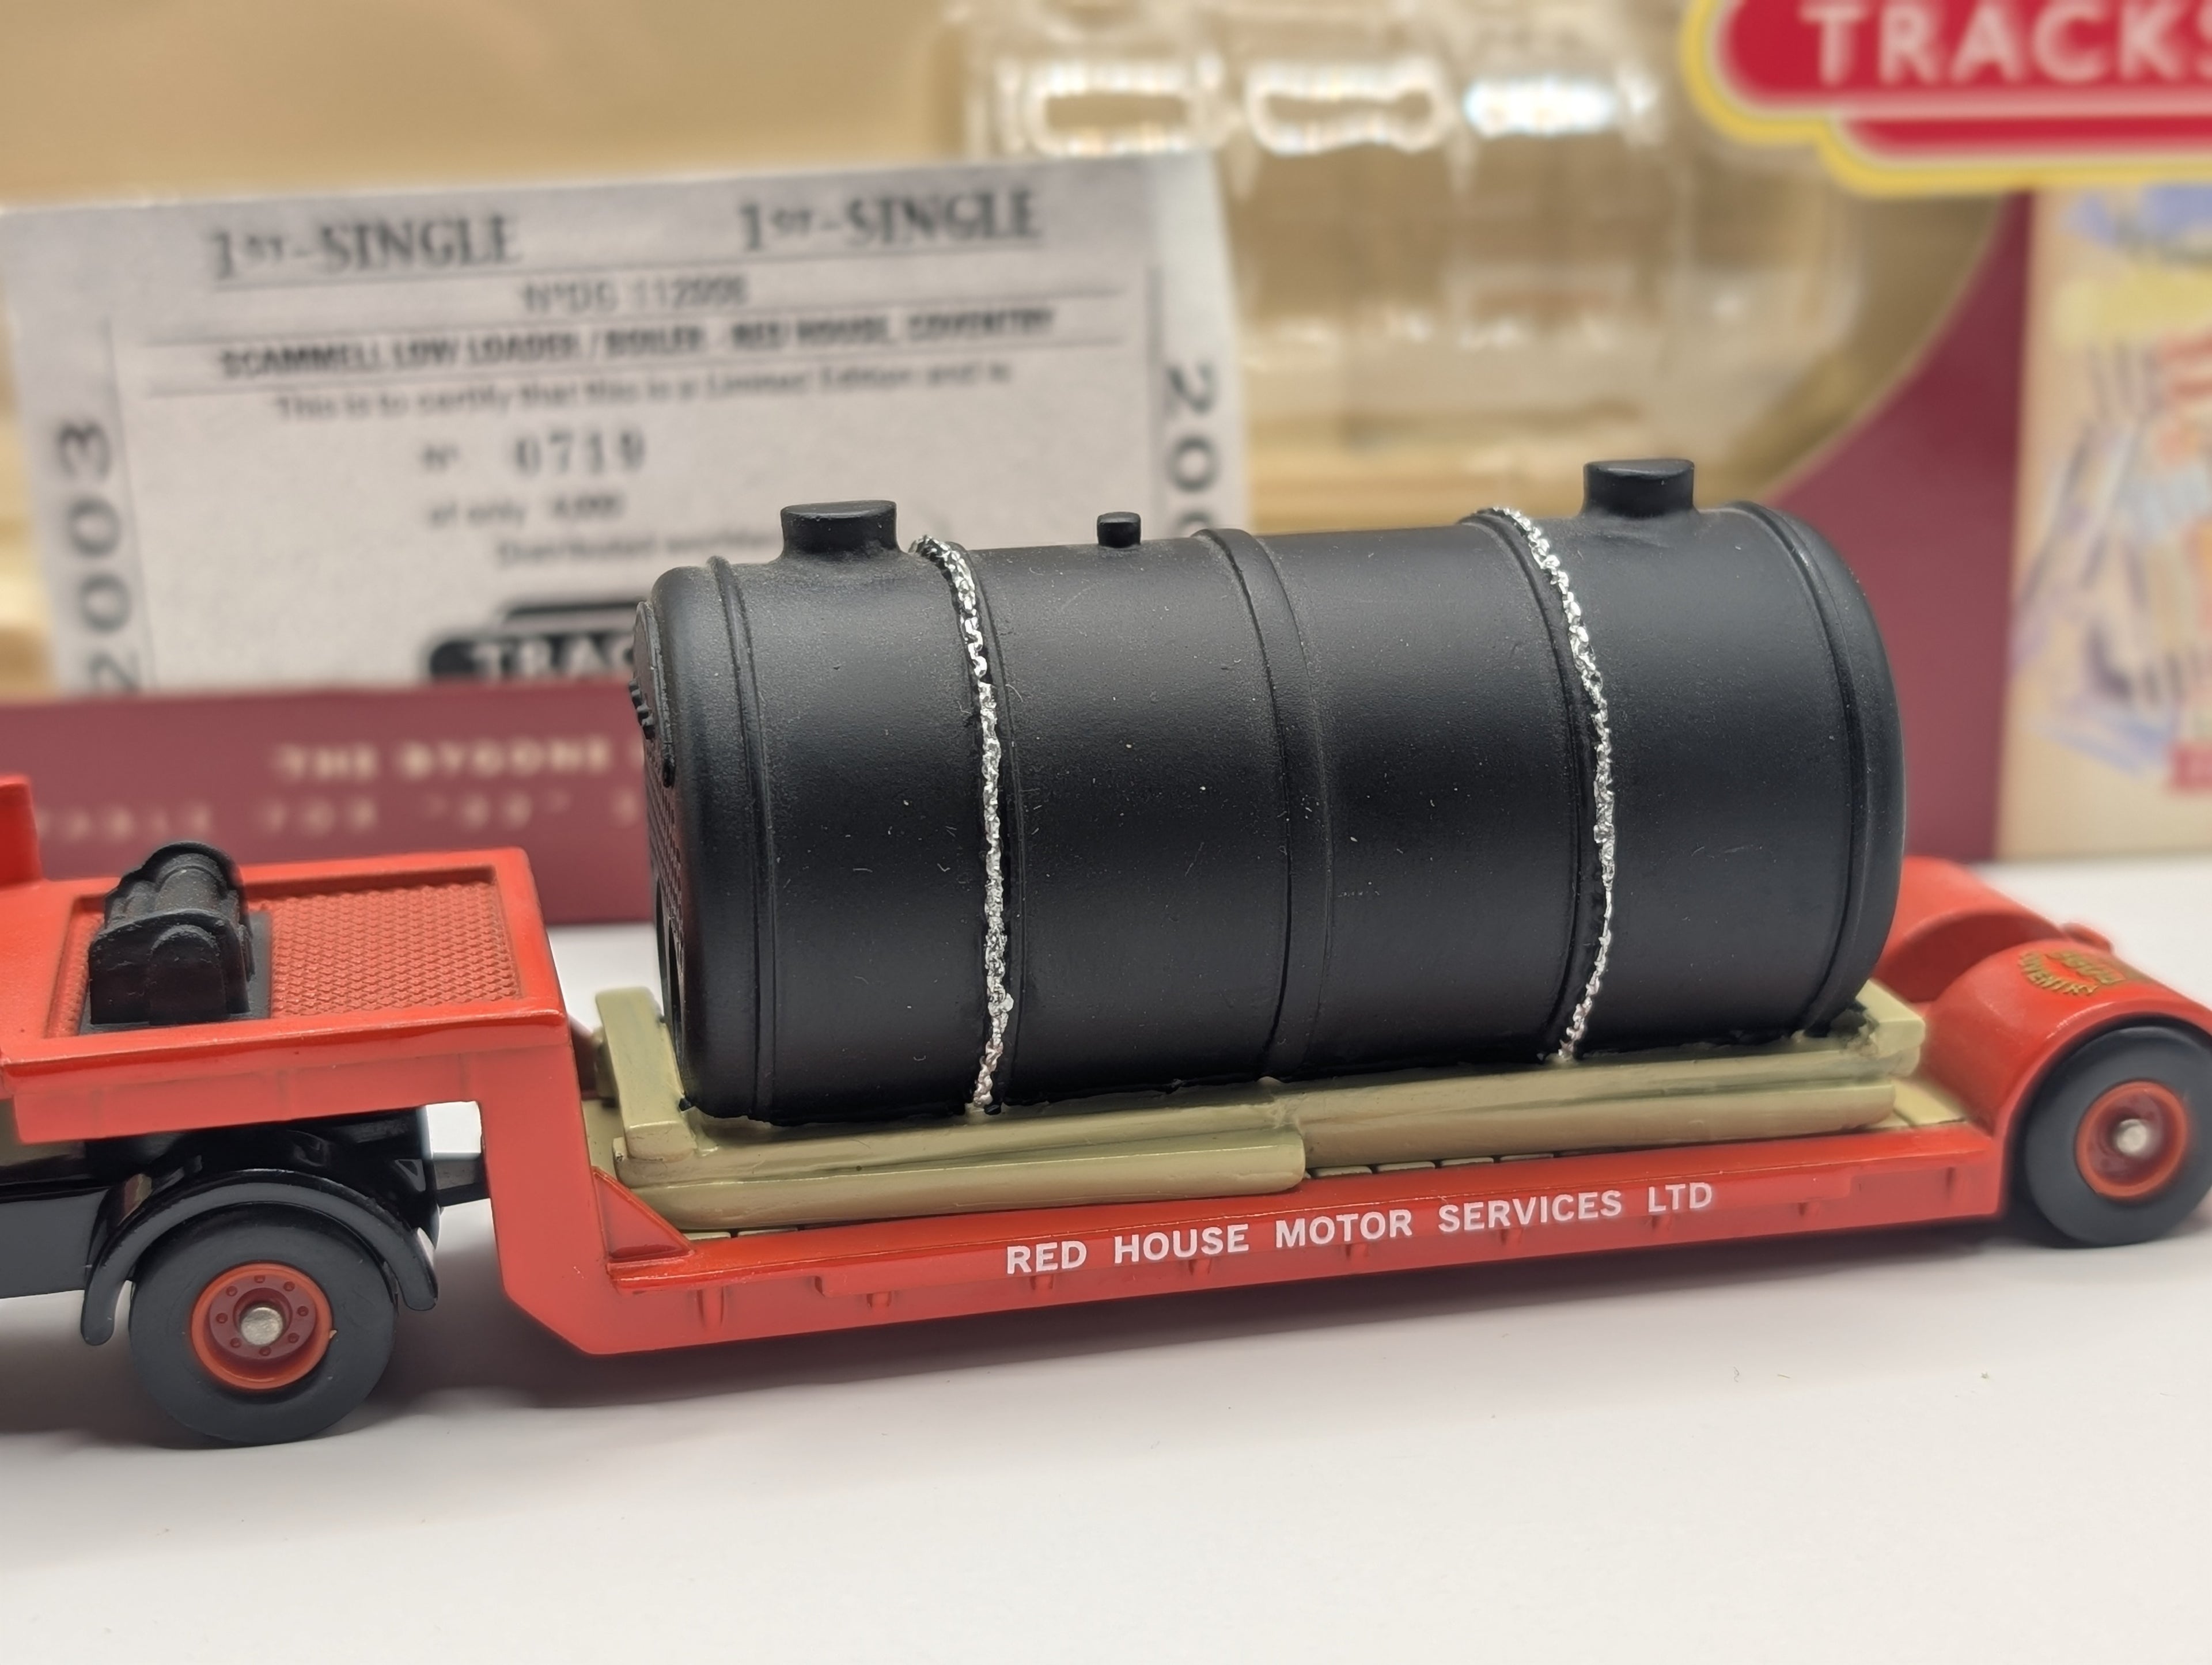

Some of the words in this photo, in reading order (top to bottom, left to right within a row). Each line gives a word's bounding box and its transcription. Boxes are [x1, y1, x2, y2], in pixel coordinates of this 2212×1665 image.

[1800, 1, 2212, 85] TRACK
[395, 340, 459, 369] LOW
[468, 332, 578, 365] LOADER
[1005, 1240, 1088, 1277] RED
[1113, 1223, 1250, 1267] HOUSE
[1275, 1208, 1414, 1250] MOTOR
[1437, 1189, 1626, 1237] SERVICES
[1647, 1181, 1717, 1217] LTD
